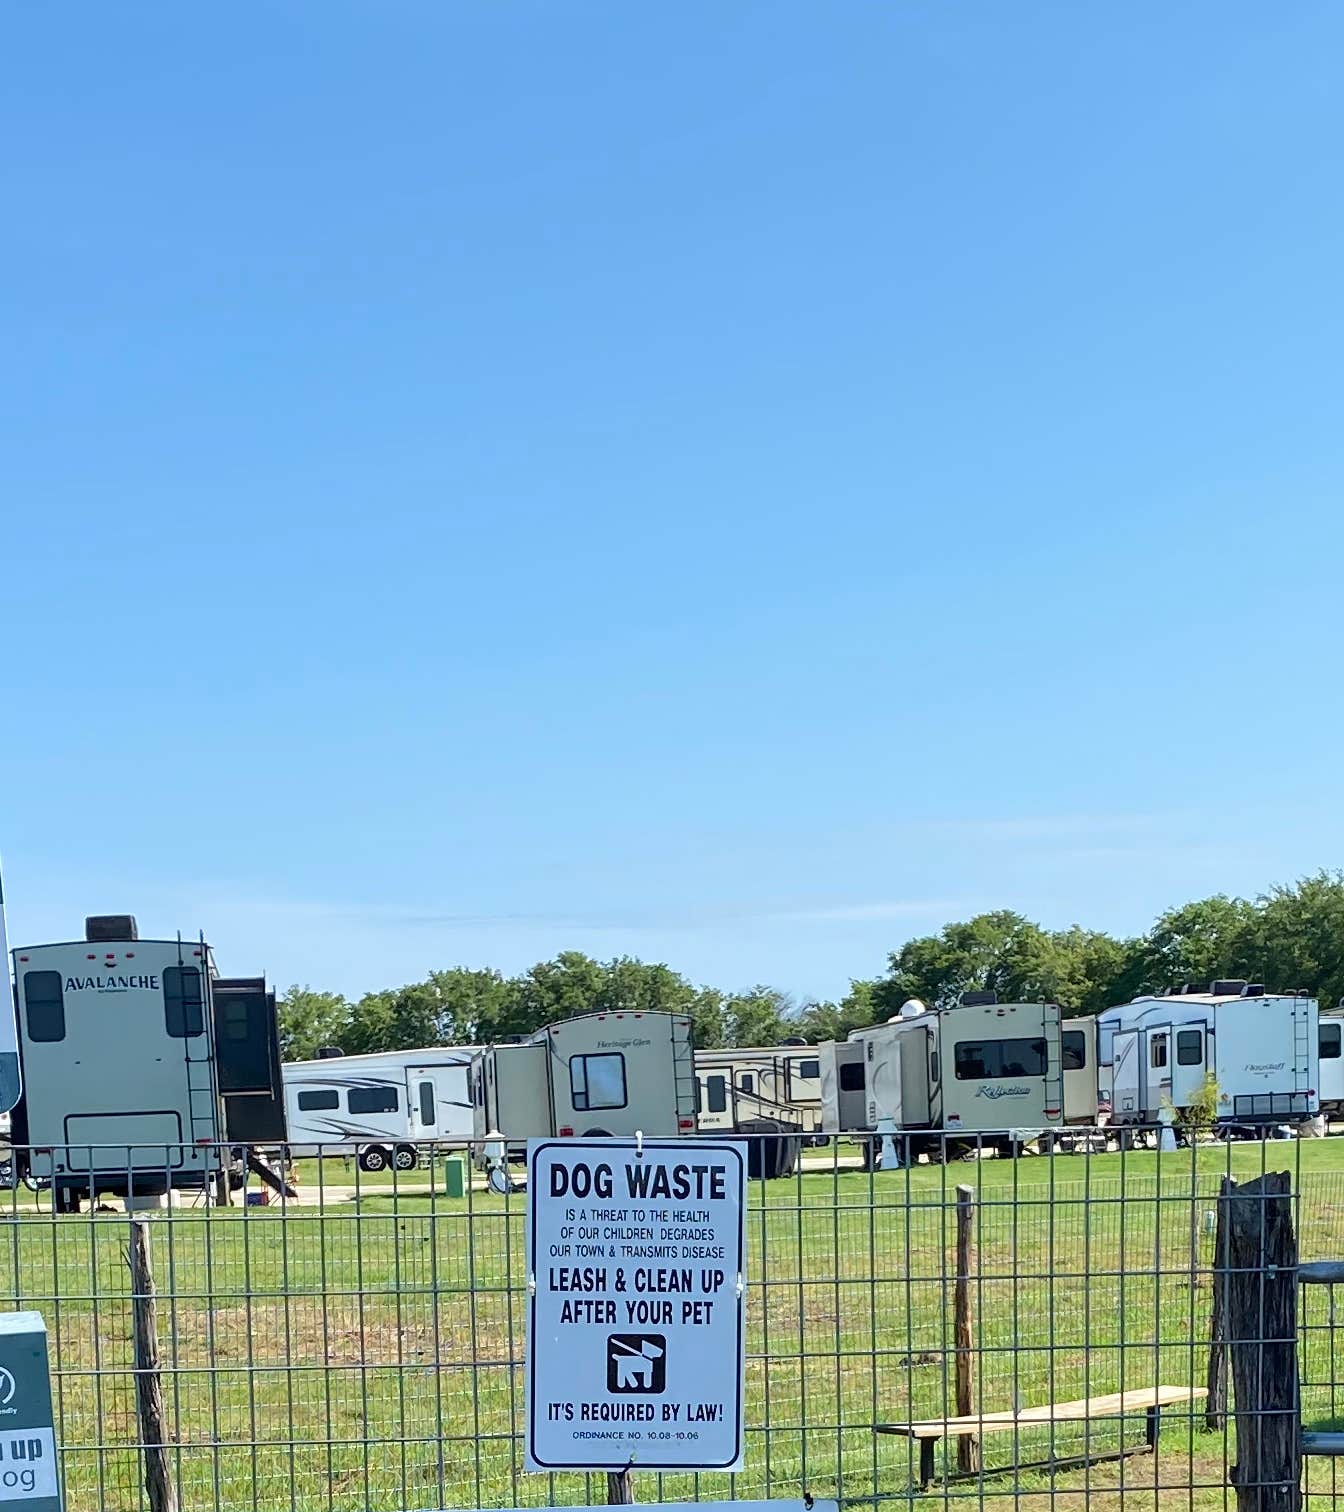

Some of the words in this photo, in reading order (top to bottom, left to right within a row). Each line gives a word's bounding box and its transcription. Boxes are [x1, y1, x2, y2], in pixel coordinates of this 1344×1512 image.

[64, 975, 159, 992] AVALANCHE
[550, 1163, 613, 1199] DOG
[625, 1164, 726, 1200] WASTE
[566, 1209, 575, 1221] IS
[579, 1209, 587, 1221] A
[591, 1209, 628, 1222] THREAT
[632, 1210, 645, 1222] TO
[650, 1210, 669, 1222] THE
[673, 1210, 710, 1222] HEALTH
[561, 1226, 574, 1239] OF
[578, 1227, 599, 1239] OUR
[603, 1227, 654, 1240] CHILDREN
[660, 1228, 715, 1240] DEGRADES
[550, 1244, 571, 1257] OUR
[575, 1245, 605, 1257] TOWN
[609, 1245, 616, 1257] &
[620, 1246, 678, 1258] TRANSMITS
[682, 1246, 725, 1259] DISEASE
[549, 1267, 607, 1292] LEASH
[614, 1268, 627, 1292] &
[634, 1268, 693, 1293] CLEAN
[701, 1269, 724, 1293] UP
[560, 1300, 617, 1324] AFTER
[625, 1300, 673, 1324] YOUR
[682, 1301, 713, 1325] PET
[548, 1402, 574, 1421] IT'S
[581, 1402, 655, 1422] REQUIRED
[662, 1403, 681, 1421] BY
[687, 1403, 723, 1422] LAW!
[572, 1431, 624, 1440] ORDINANCE
[628, 1431, 644, 1440] NO.
[10, 1438, 43, 1462] up
